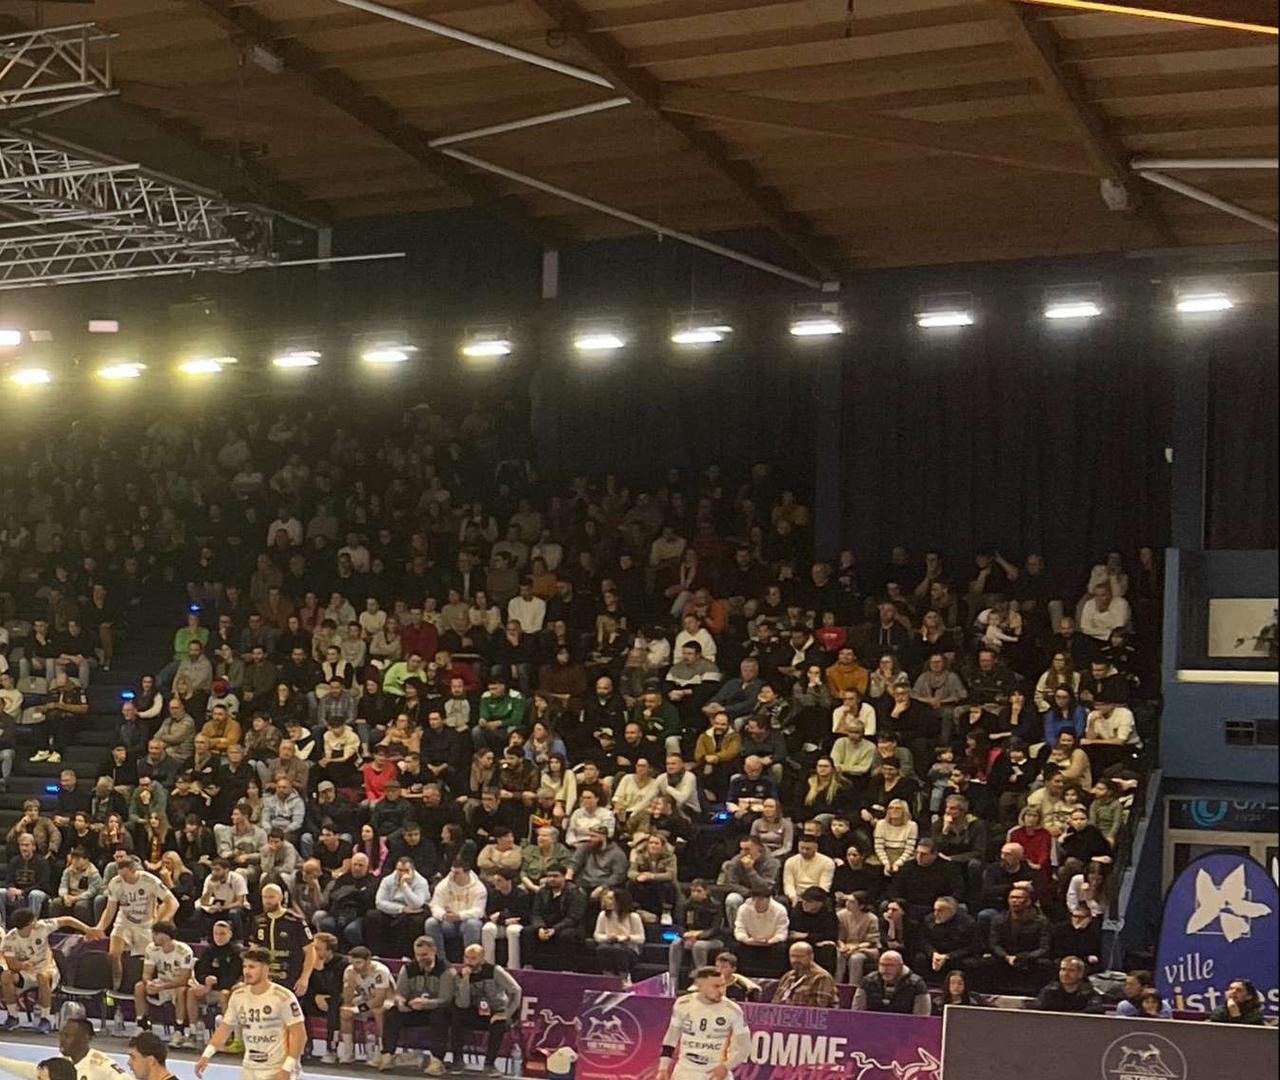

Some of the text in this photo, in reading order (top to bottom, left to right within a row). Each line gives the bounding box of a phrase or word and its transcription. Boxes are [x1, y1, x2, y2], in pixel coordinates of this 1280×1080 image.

[1163, 952, 1215, 983] ville
[248, 1008, 261, 1023] 33
[699, 1018, 708, 1032] 8
[742, 1030, 848, 1072] OMME
